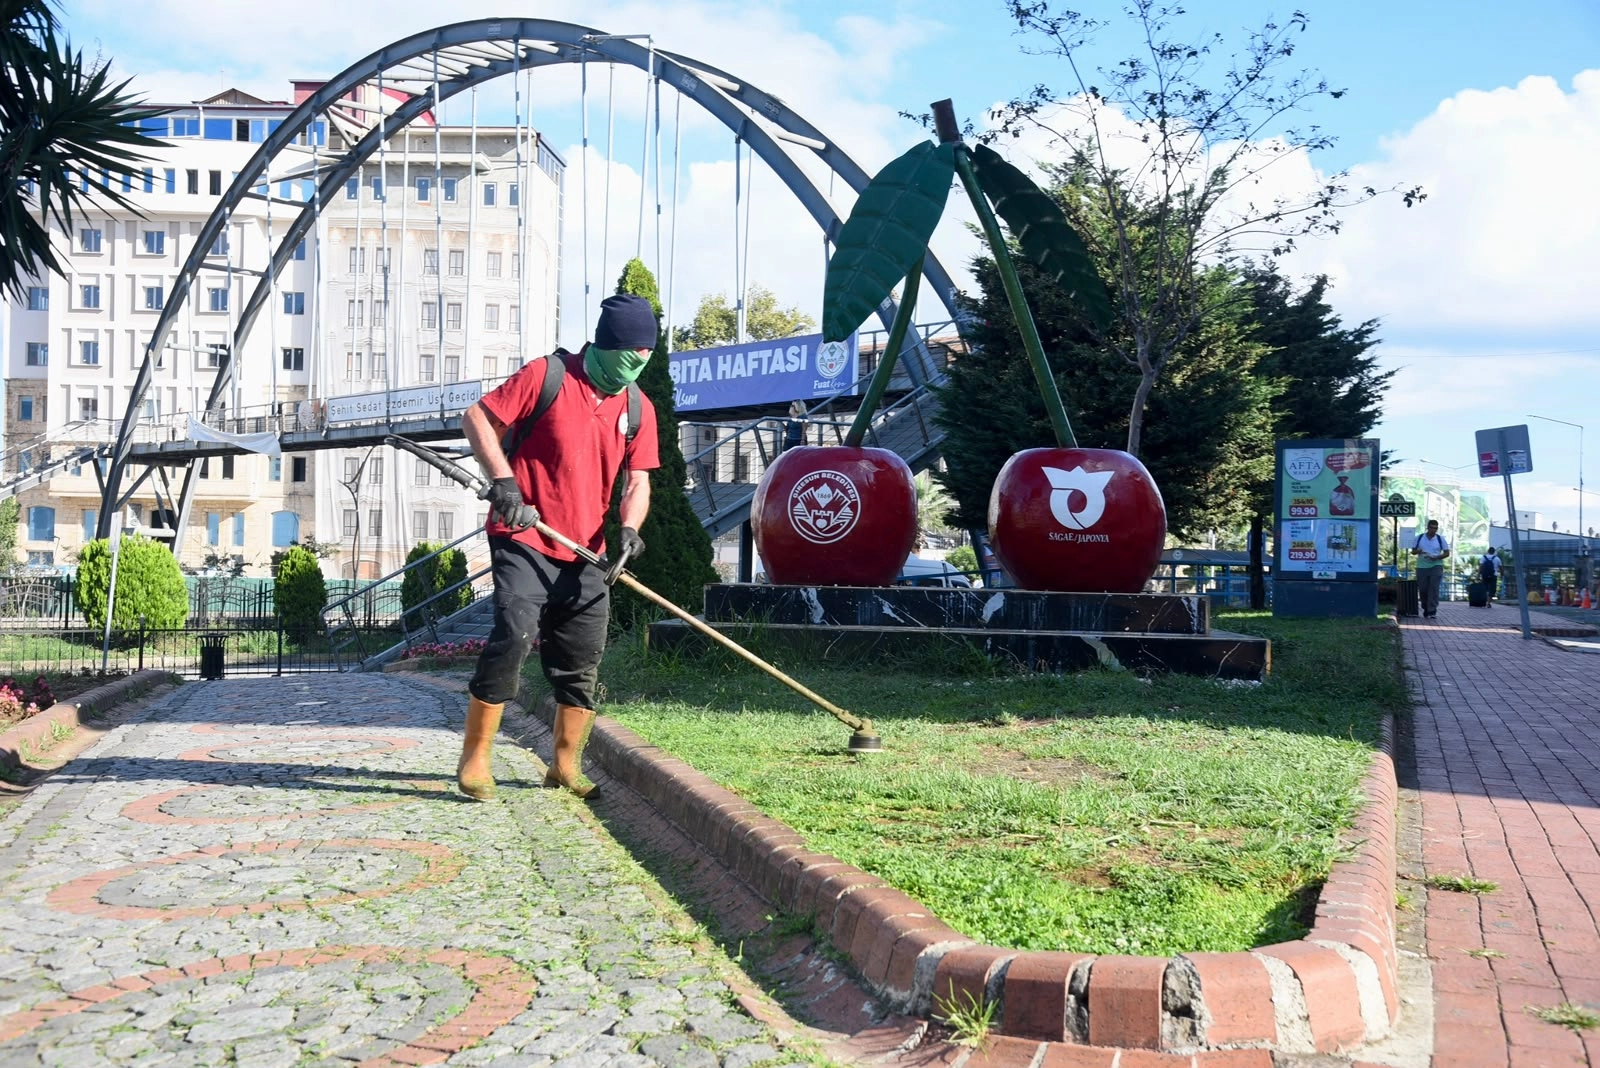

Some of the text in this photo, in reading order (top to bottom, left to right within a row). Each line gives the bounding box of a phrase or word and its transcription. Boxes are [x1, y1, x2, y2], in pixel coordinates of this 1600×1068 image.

[717, 344, 808, 381] HAFTASI
[356, 400, 382, 413] Sedat
[448, 390, 479, 403] Geçidi
[1289, 461, 1321, 470] AFTA
[1290, 507, 1316, 515] 99.90
[1289, 551, 1316, 559] 219.90
